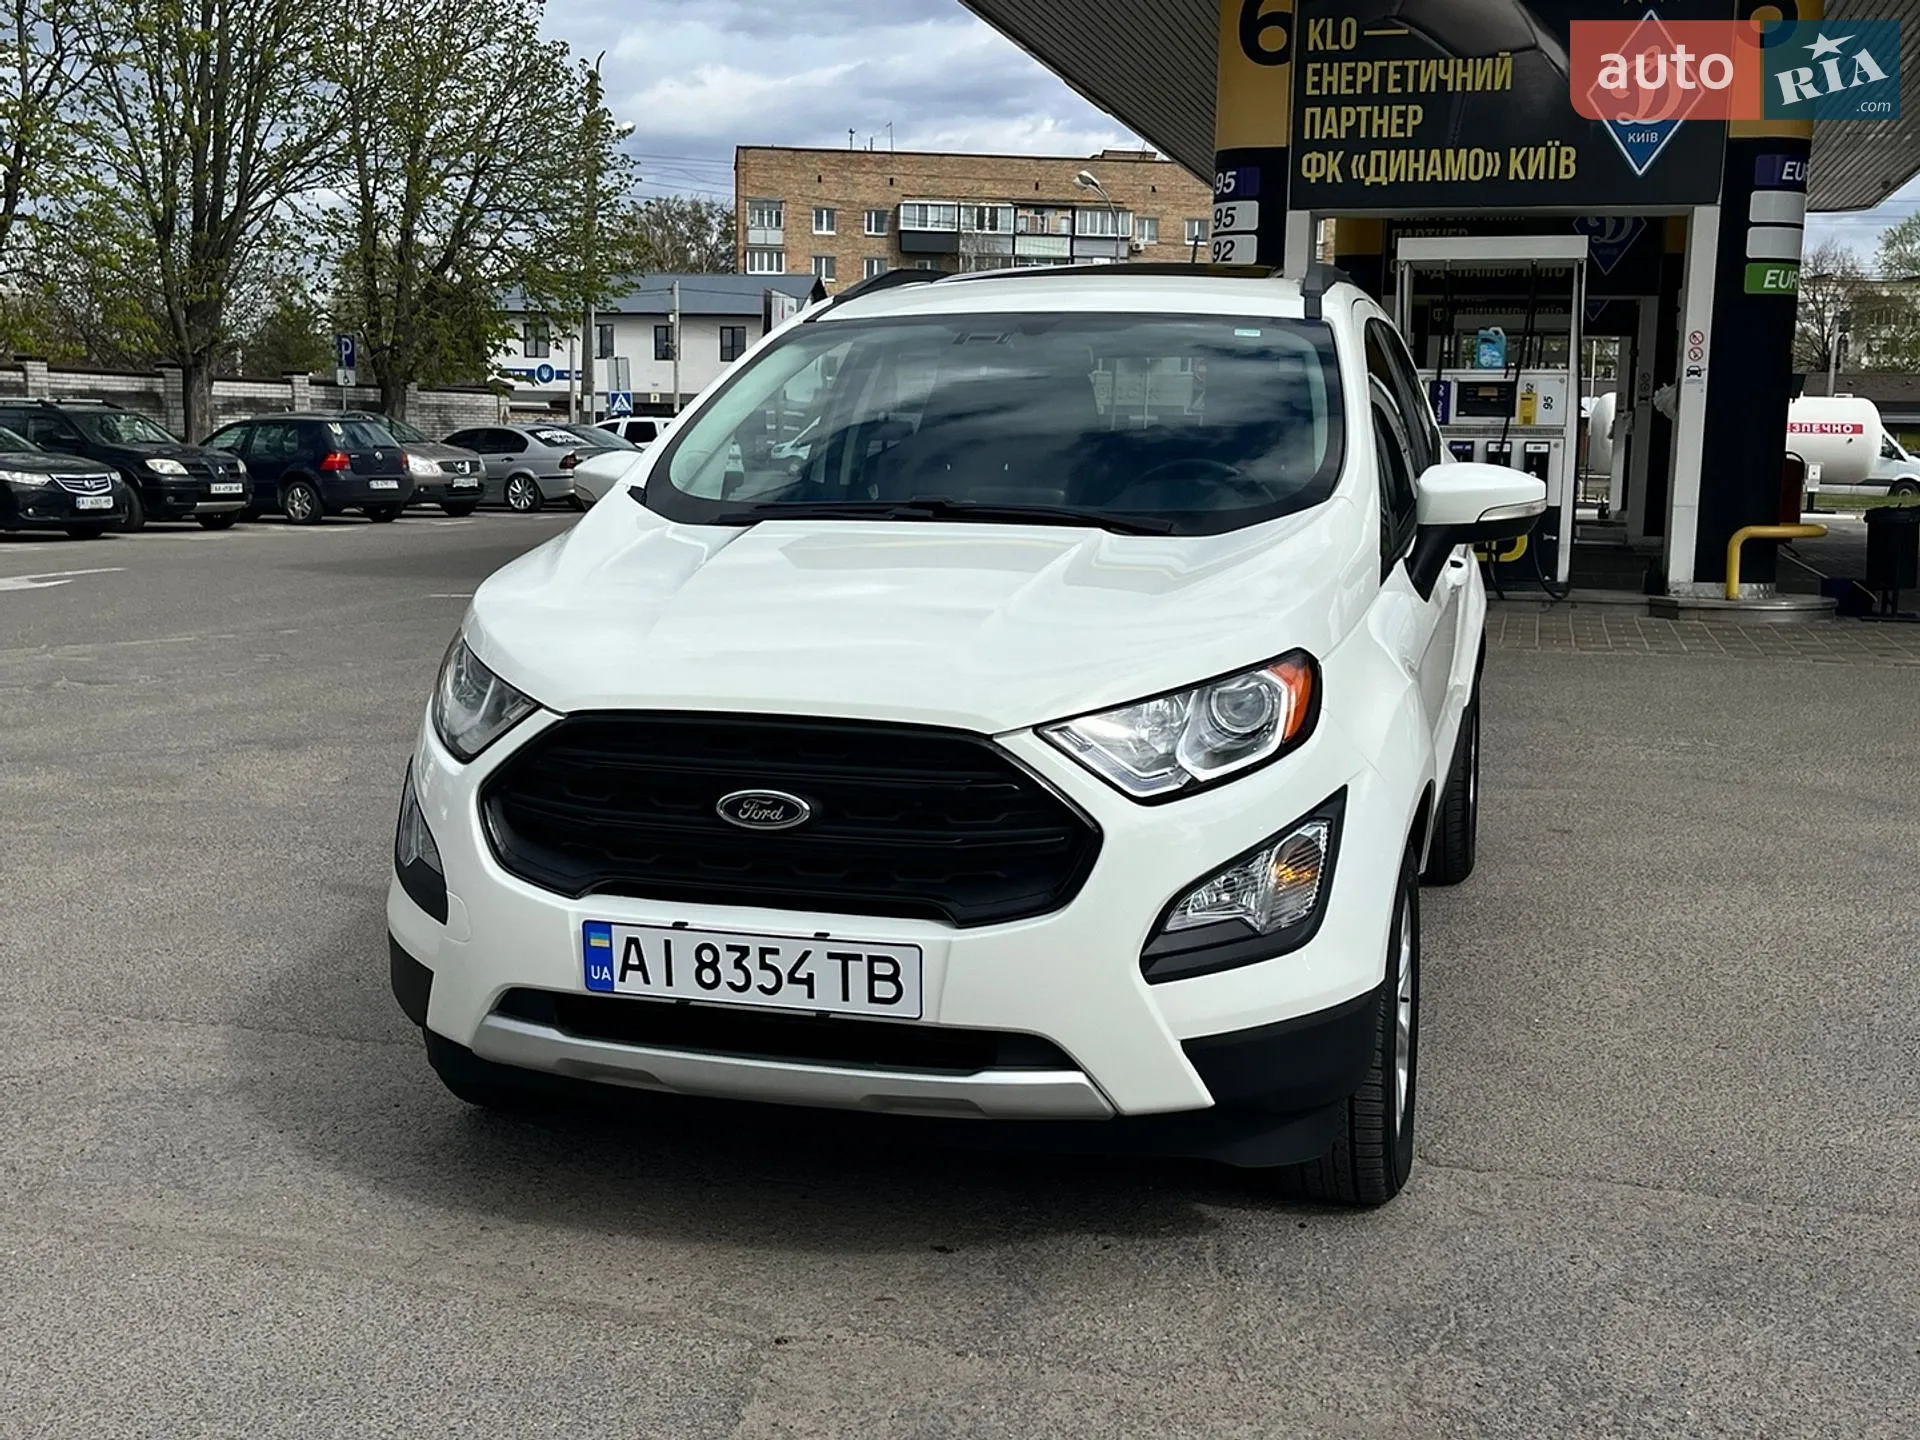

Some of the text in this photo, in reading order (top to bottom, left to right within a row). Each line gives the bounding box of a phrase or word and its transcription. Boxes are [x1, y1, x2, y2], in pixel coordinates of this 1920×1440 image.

[1307, 16, 1358, 51] KLO
[1305, 52, 1513, 96] ЕНЕРГЕТИЧНИЙ
[1303, 104, 1424, 140] ПАРТНЕР
[1627, 129, 1659, 144] КИЇВ
[1301, 140, 1577, 187] ФК «ДИНАМО» КИЇВ
[1781, 161, 1808, 181] EU
[1216, 171, 1237, 195] 95
[1214, 206, 1237, 230] 95
[1213, 240, 1235, 263] 92
[1542, 396, 1554, 411] 95
[738, 799, 784, 821] Ford
[590, 965, 611, 981] UA
[618, 936, 905, 1005] AI 8354 TB
